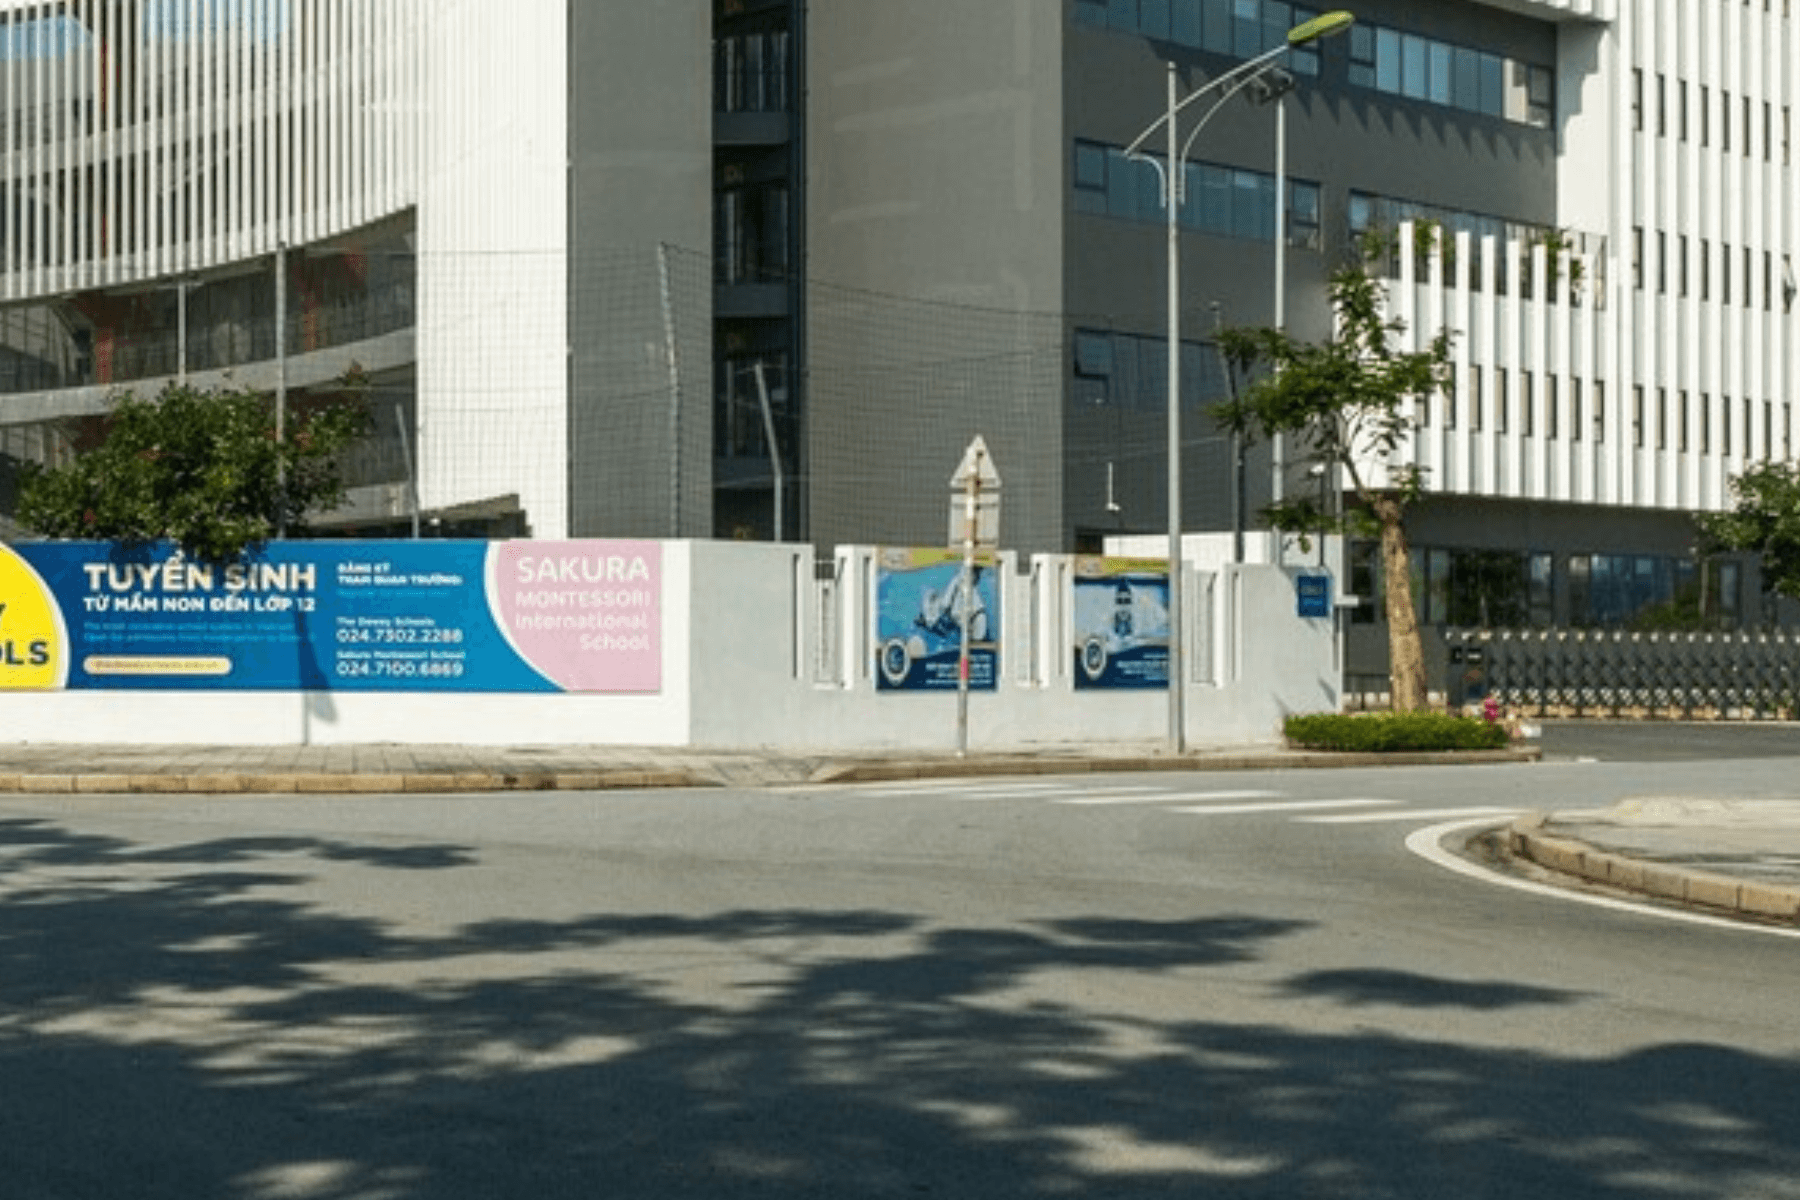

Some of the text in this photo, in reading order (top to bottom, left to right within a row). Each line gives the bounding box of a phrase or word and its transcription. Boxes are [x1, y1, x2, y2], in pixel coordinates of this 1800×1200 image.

[83, 549, 316, 591] TUYỂN SINH
[516, 556, 650, 584] SAKURA
[84, 593, 109, 612] TỪ
[162, 597, 205, 612] NON
[209, 591, 249, 612] ĐẾN
[254, 593, 293, 612] LỚP
[297, 597, 316, 612] 12
[515, 590, 650, 609] MONTESSORI
[516, 612, 650, 631] International
[579, 634, 650, 651] School
